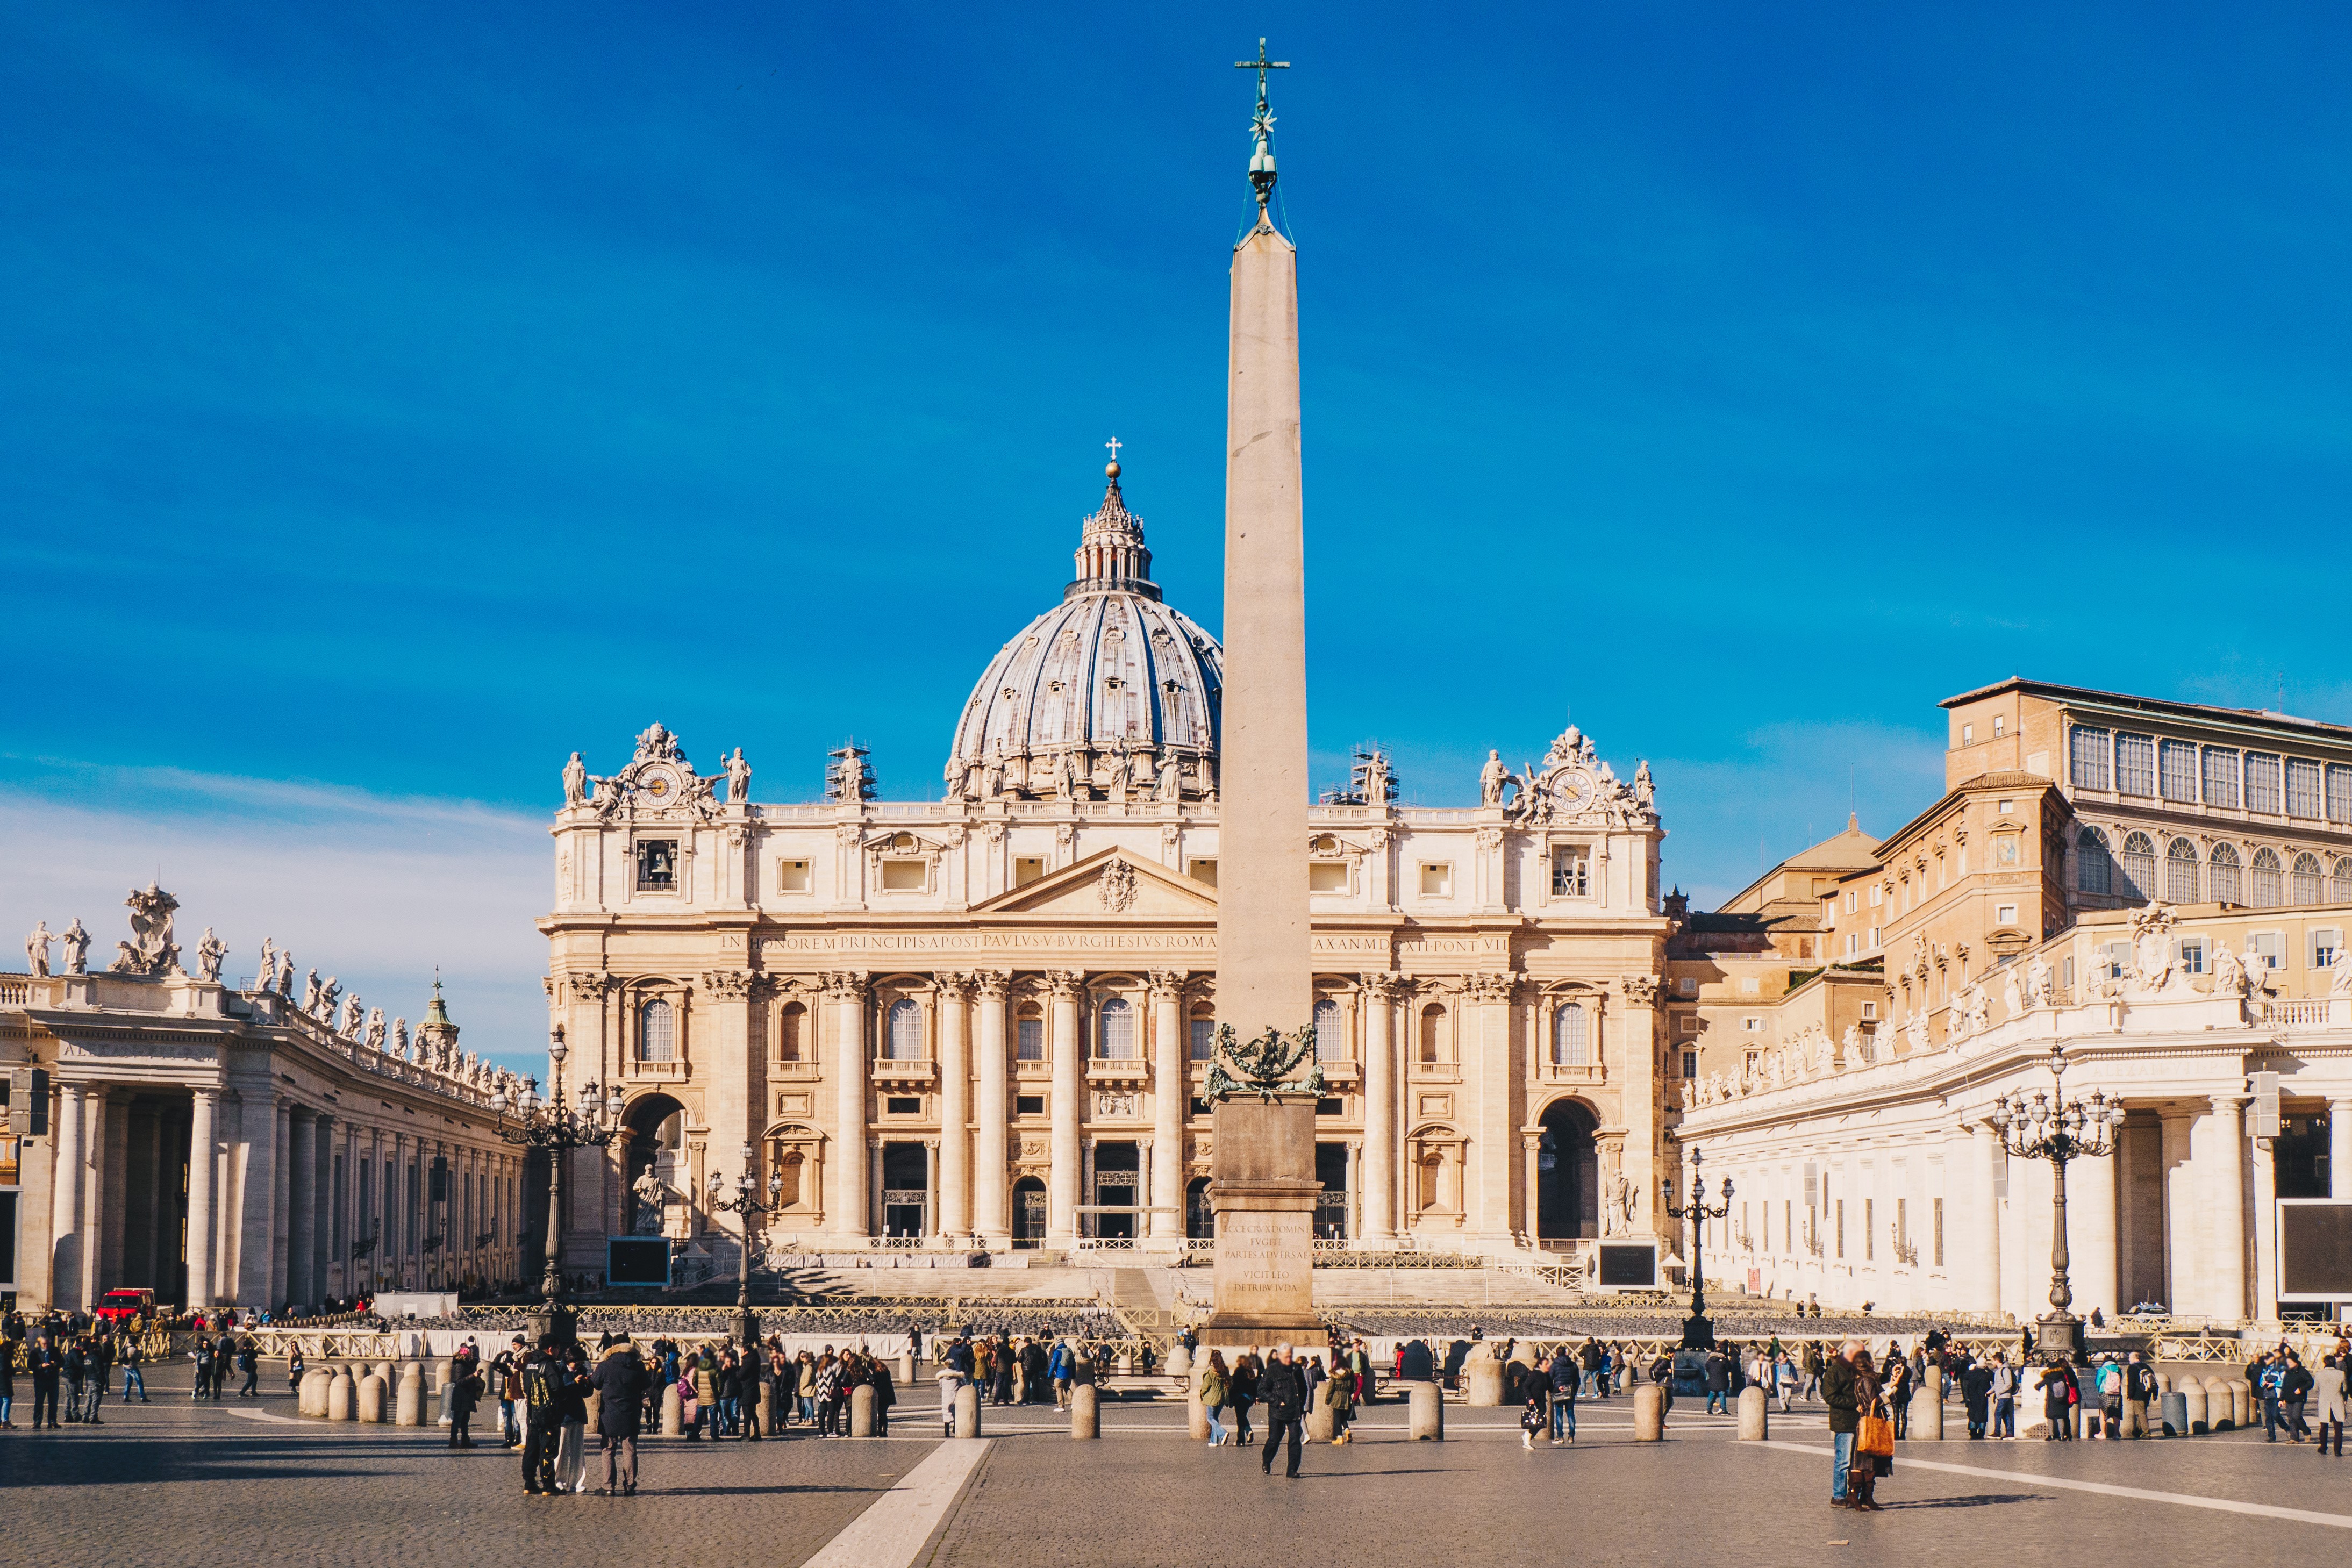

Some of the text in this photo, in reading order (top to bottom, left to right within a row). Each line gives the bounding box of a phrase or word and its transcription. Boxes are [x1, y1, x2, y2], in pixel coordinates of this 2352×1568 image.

[722, 936, 740, 947] IN
[750, 937, 835, 949] HONOREM
[841, 936, 925, 948] PRINCIPIS
[930, 936, 981, 948] APOST
[983, 935, 1039, 947] PAVLVS
[1057, 935, 1161, 947] BVRGHESIVS
[1435, 941, 1477, 952] PONT
[1484, 939, 1506, 950] VII
[1250, 1238, 1282, 1246] FVGITE
